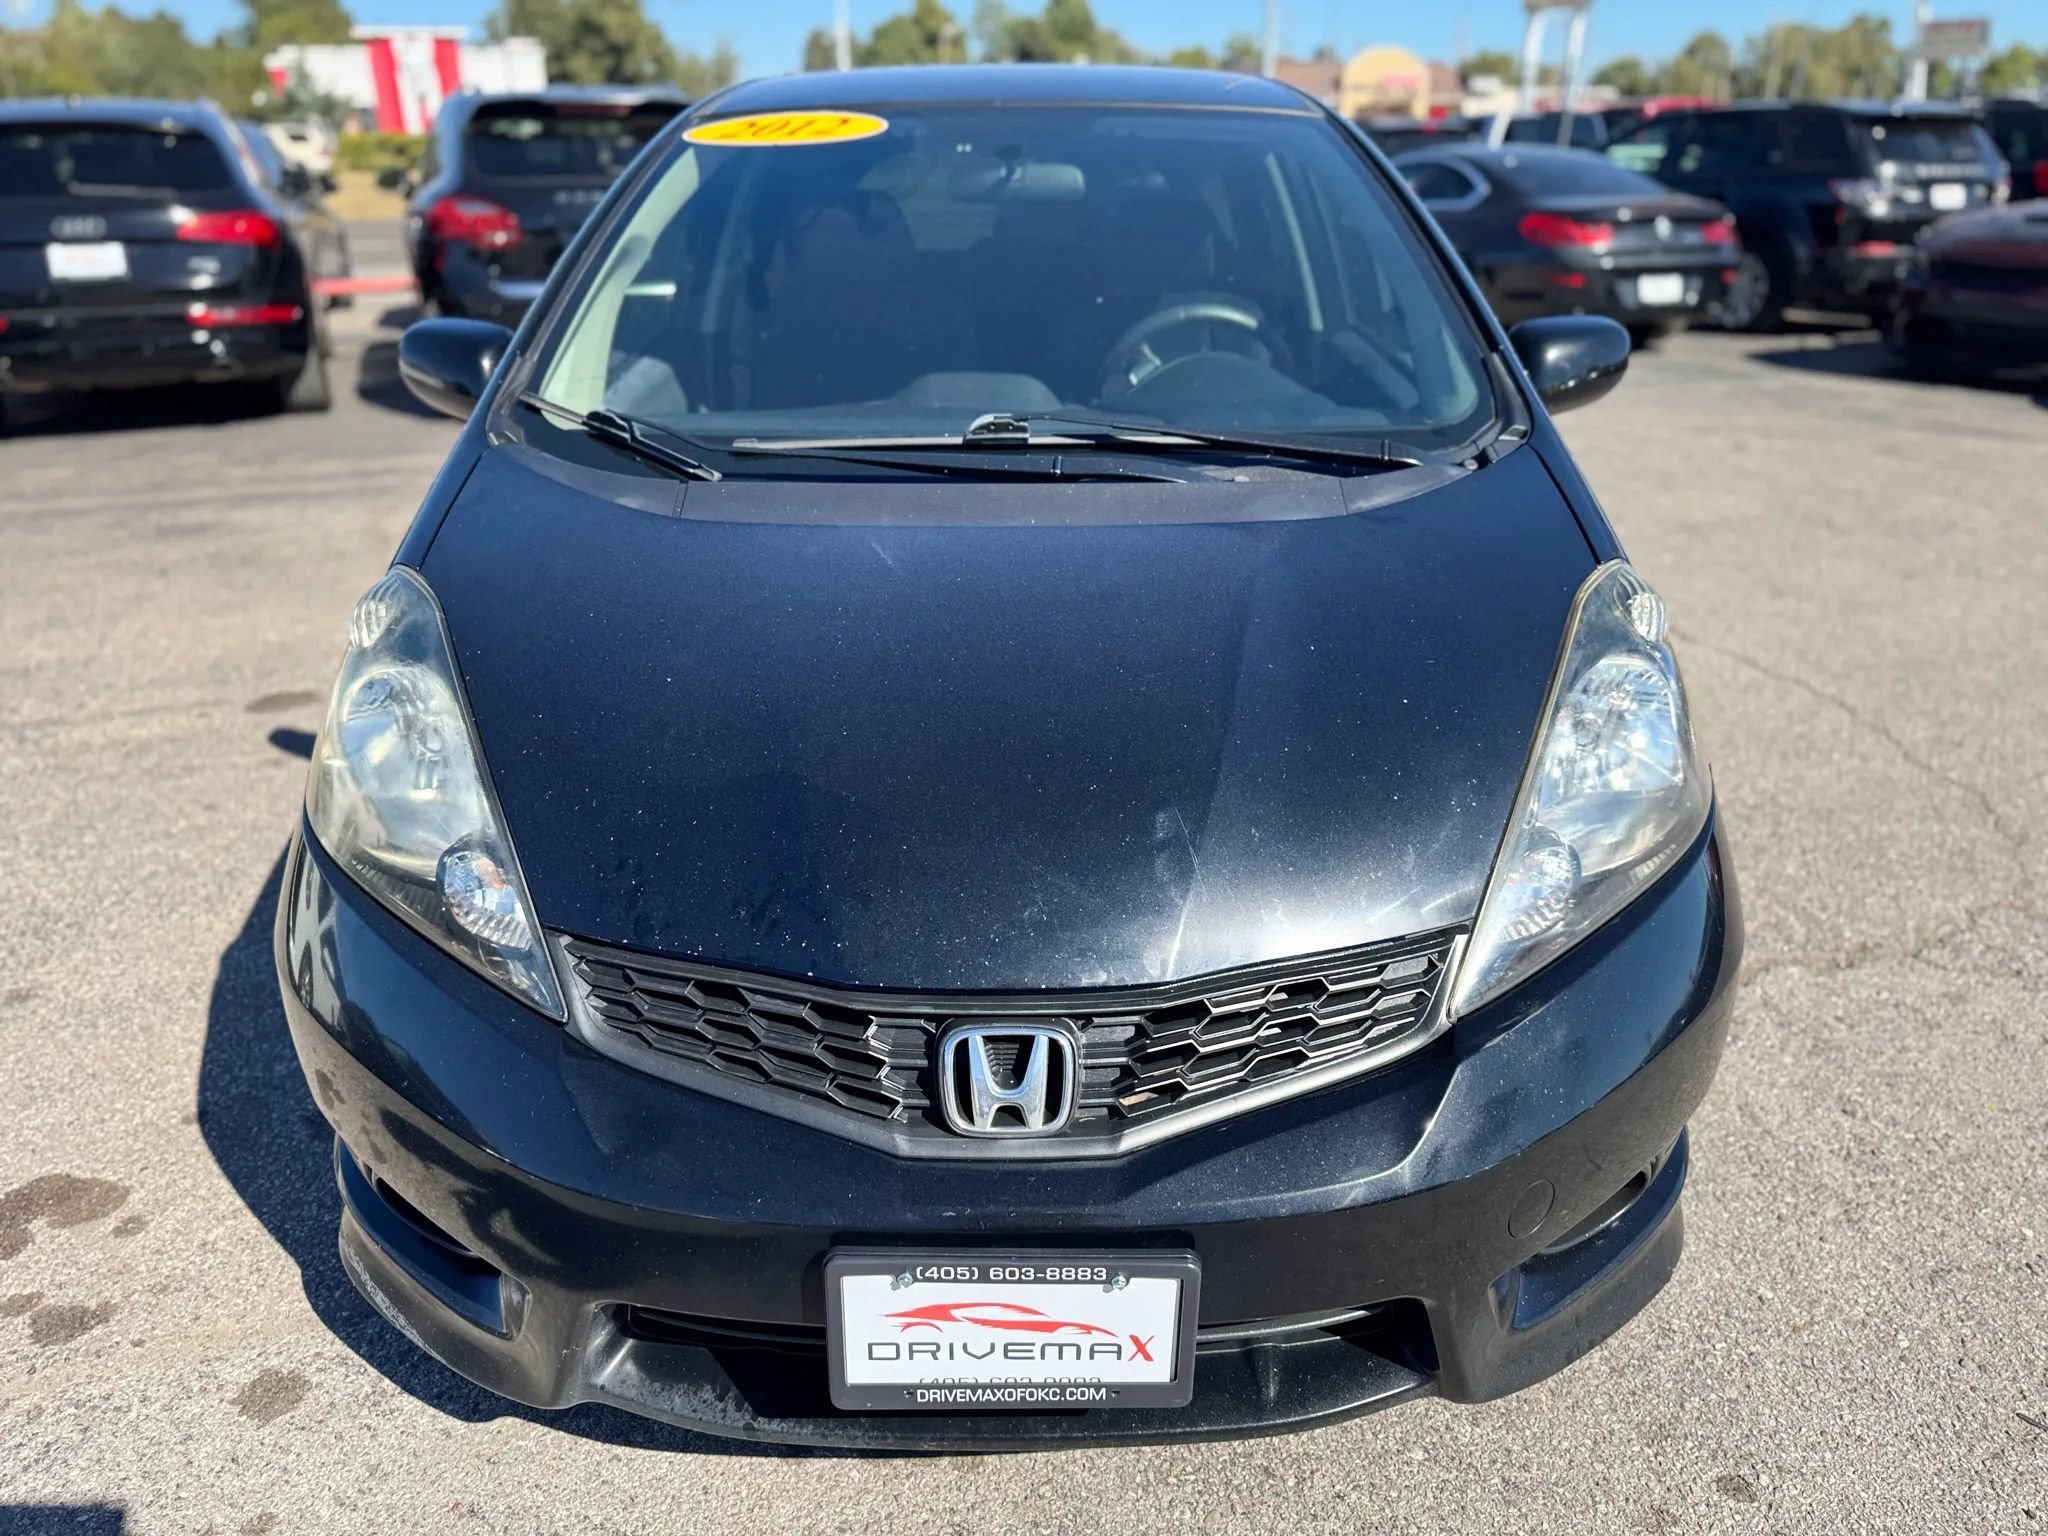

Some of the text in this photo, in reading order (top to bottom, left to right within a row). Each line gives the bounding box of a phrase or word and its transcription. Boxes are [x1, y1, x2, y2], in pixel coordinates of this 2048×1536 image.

[711, 115, 853, 140] 2012
[915, 1266, 1108, 1281] (405) 603-8883
[867, 1333, 1156, 1362] DRIVEMAX
[916, 1387, 1107, 1403] DRIVEMAXOFOKC.COM
